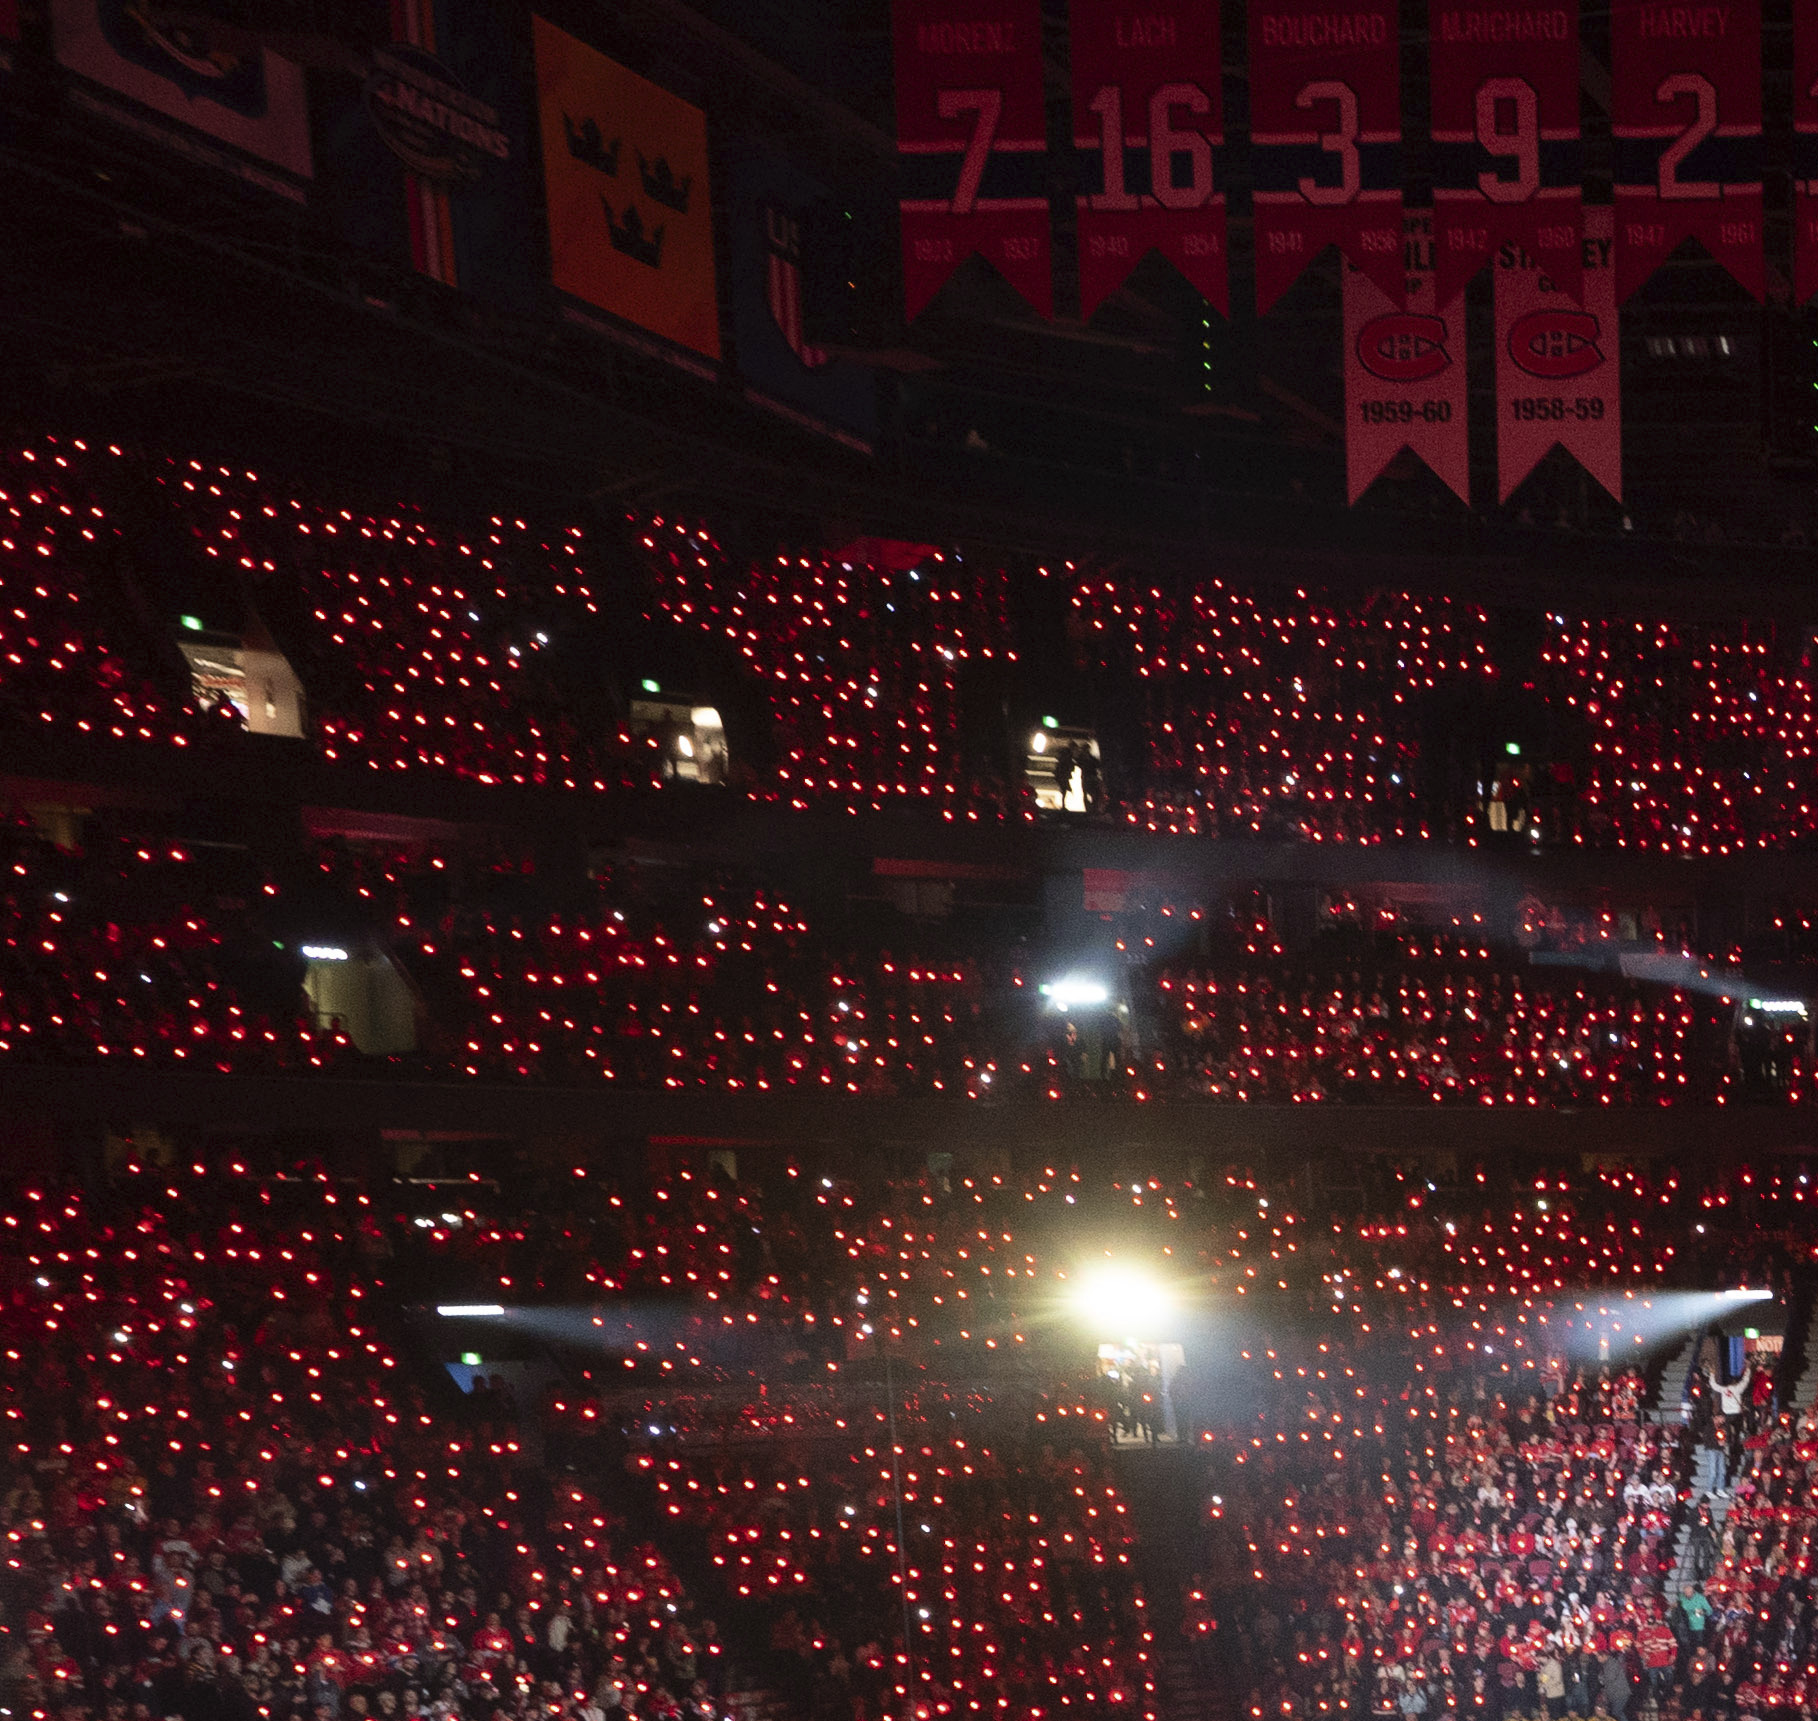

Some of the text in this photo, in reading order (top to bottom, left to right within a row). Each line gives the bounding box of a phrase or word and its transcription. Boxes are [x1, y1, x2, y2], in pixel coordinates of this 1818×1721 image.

[916, 21, 1015, 55] MORENZ
[1115, 16, 1177, 48] LACH
[1262, 13, 1387, 48] BOUCHARD
[1639, 6, 1730, 39] HARVEY
[937, 87, 1002, 215] 7
[1089, 82, 1214, 211] 16
[1295, 80, 1361, 207] 3
[1473, 76, 1542, 203] 9
[1655, 73, 1723, 200] 2
[1626, 224, 1665, 247] 1947
[1359, 400, 1452, 424] 1959-60
[1512, 399, 1604, 421] 1958-59
